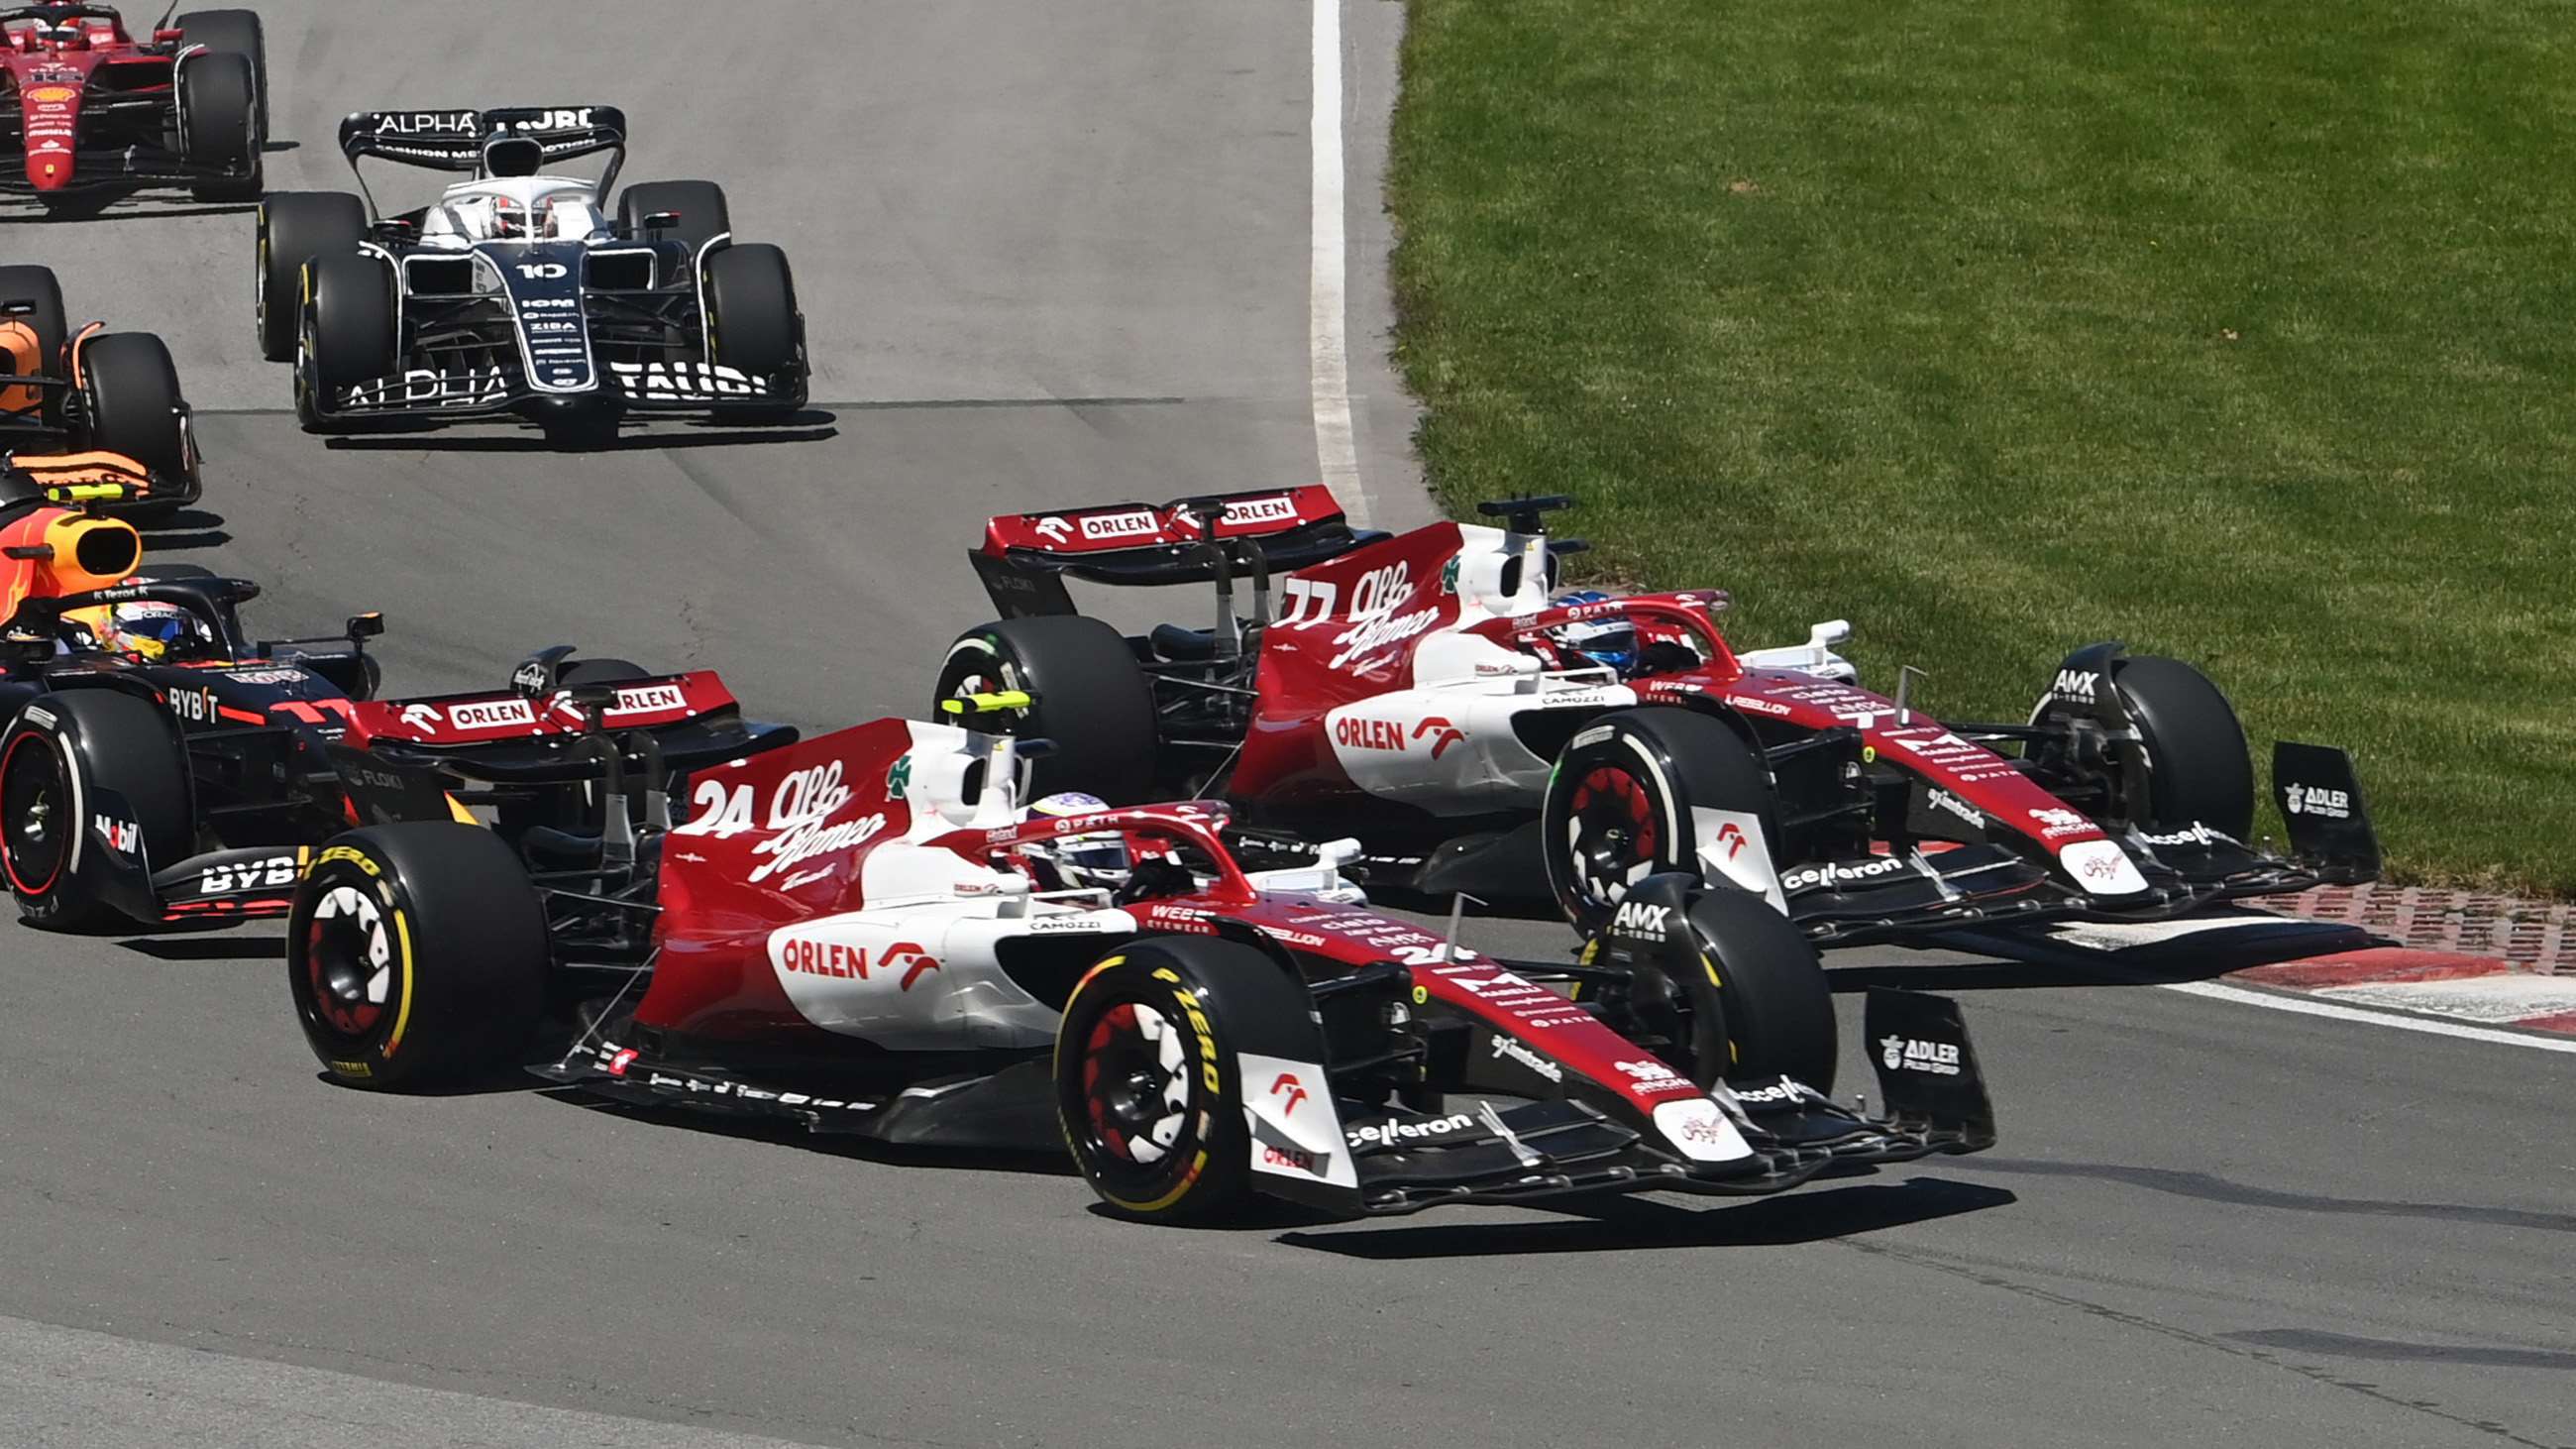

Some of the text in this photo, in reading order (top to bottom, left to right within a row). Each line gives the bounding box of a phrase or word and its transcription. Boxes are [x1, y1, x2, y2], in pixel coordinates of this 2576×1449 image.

[378, 112, 477, 133] ALPHA
[514, 263, 568, 279] 10
[1086, 514, 1150, 535] ORLEN
[1225, 501, 1289, 521] ORLEN
[1269, 578, 1337, 631] 77
[1346, 559, 1413, 623] Alfa
[1329, 606, 1440, 669] Romeo
[2052, 668, 2100, 697] AMX
[168, 685, 219, 724] BYBIT
[456, 704, 527, 724] ORLEN
[1542, 695, 1605, 705] CAMOZZI
[1336, 716, 1406, 751] ORLEN
[671, 779, 755, 839] 24
[766, 758, 850, 831] Alfa
[2304, 785, 2349, 809] ADLER
[94, 813, 139, 854] Mobil
[747, 812, 888, 884] Romeo
[317, 845, 381, 878] ZERO
[1029, 920, 1102, 932] CAMOZZI
[1146, 919, 1210, 935] EYEWEAR
[1613, 901, 1672, 934] AMX
[783, 938, 869, 980] ORLEN
[1172, 987, 1221, 1096] ZERO
[1903, 1039, 1960, 1064] ADLER
